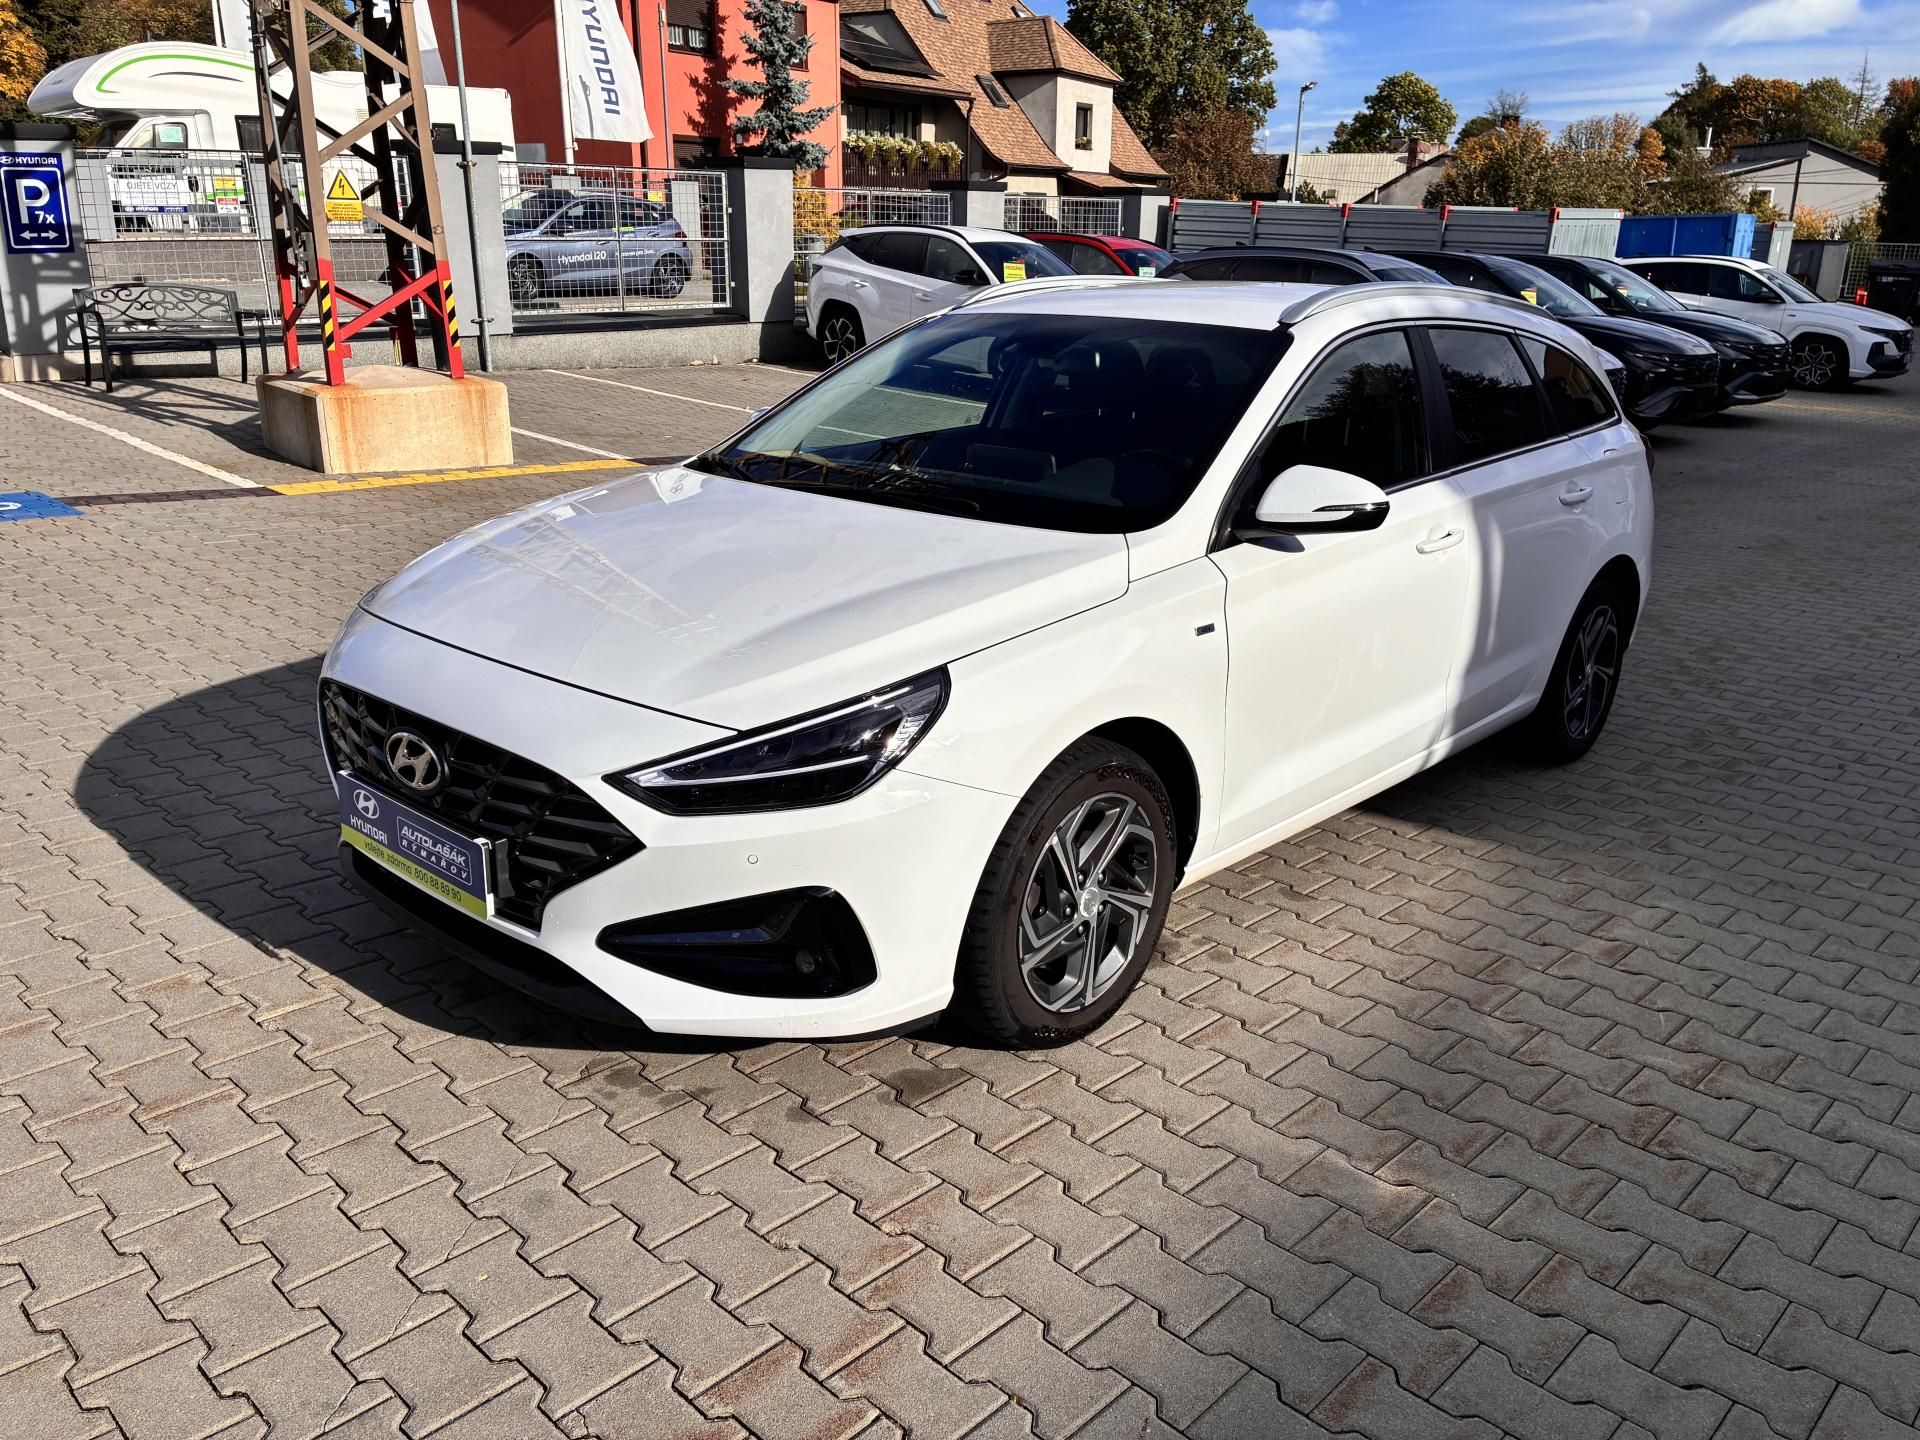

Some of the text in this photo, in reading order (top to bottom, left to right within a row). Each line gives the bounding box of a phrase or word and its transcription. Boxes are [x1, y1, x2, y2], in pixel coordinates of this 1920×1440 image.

[582, 0, 620, 115] YUNDAI
[15, 156, 57, 164] HYUNDAI
[15, 179, 50, 224] P
[34, 211, 55, 224] 7x
[558, 253, 593, 265] Hyundai
[593, 250, 607, 260] i20
[350, 814, 388, 846] HYUNDAI
[401, 826, 466, 867] AUTOLAŠÁK
[363, 840, 462, 902] volejte zdarma 800 88 89 90
